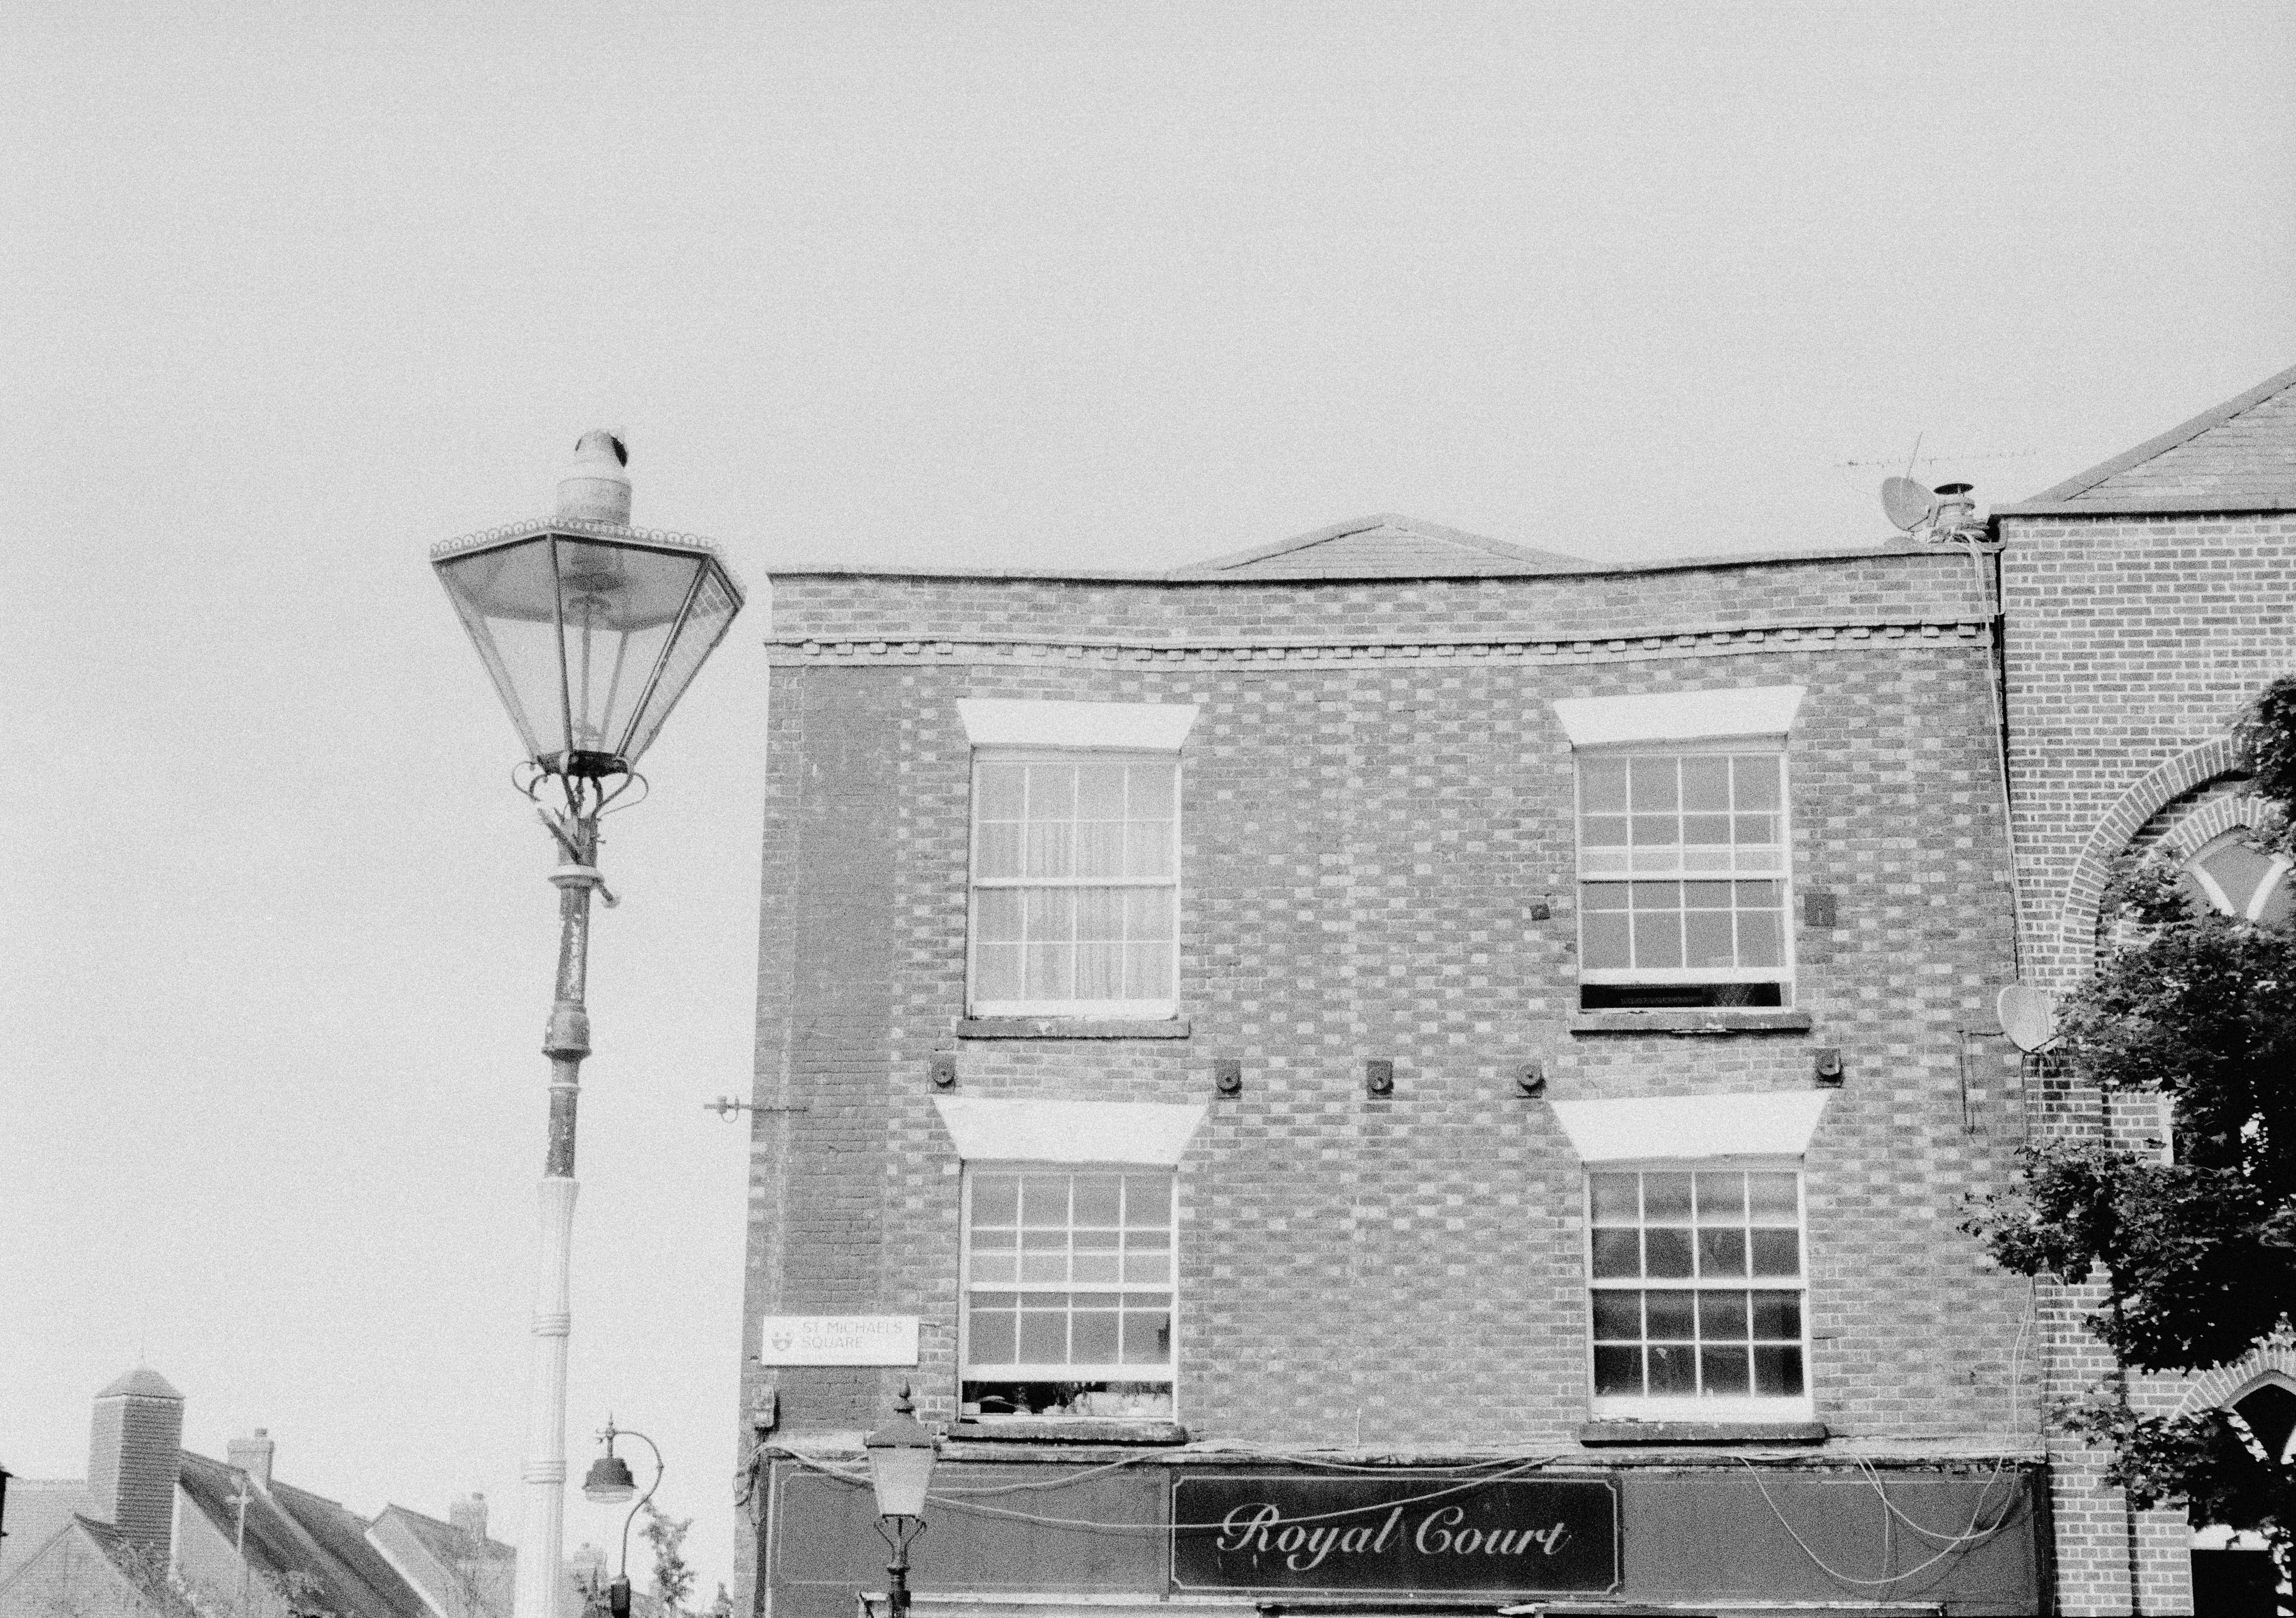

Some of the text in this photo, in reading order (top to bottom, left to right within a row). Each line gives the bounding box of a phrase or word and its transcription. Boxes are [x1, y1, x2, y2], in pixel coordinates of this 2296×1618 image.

[803, 1336, 864, 1349] SQUARE
[1217, 1503, 1571, 1570] Royal Court
